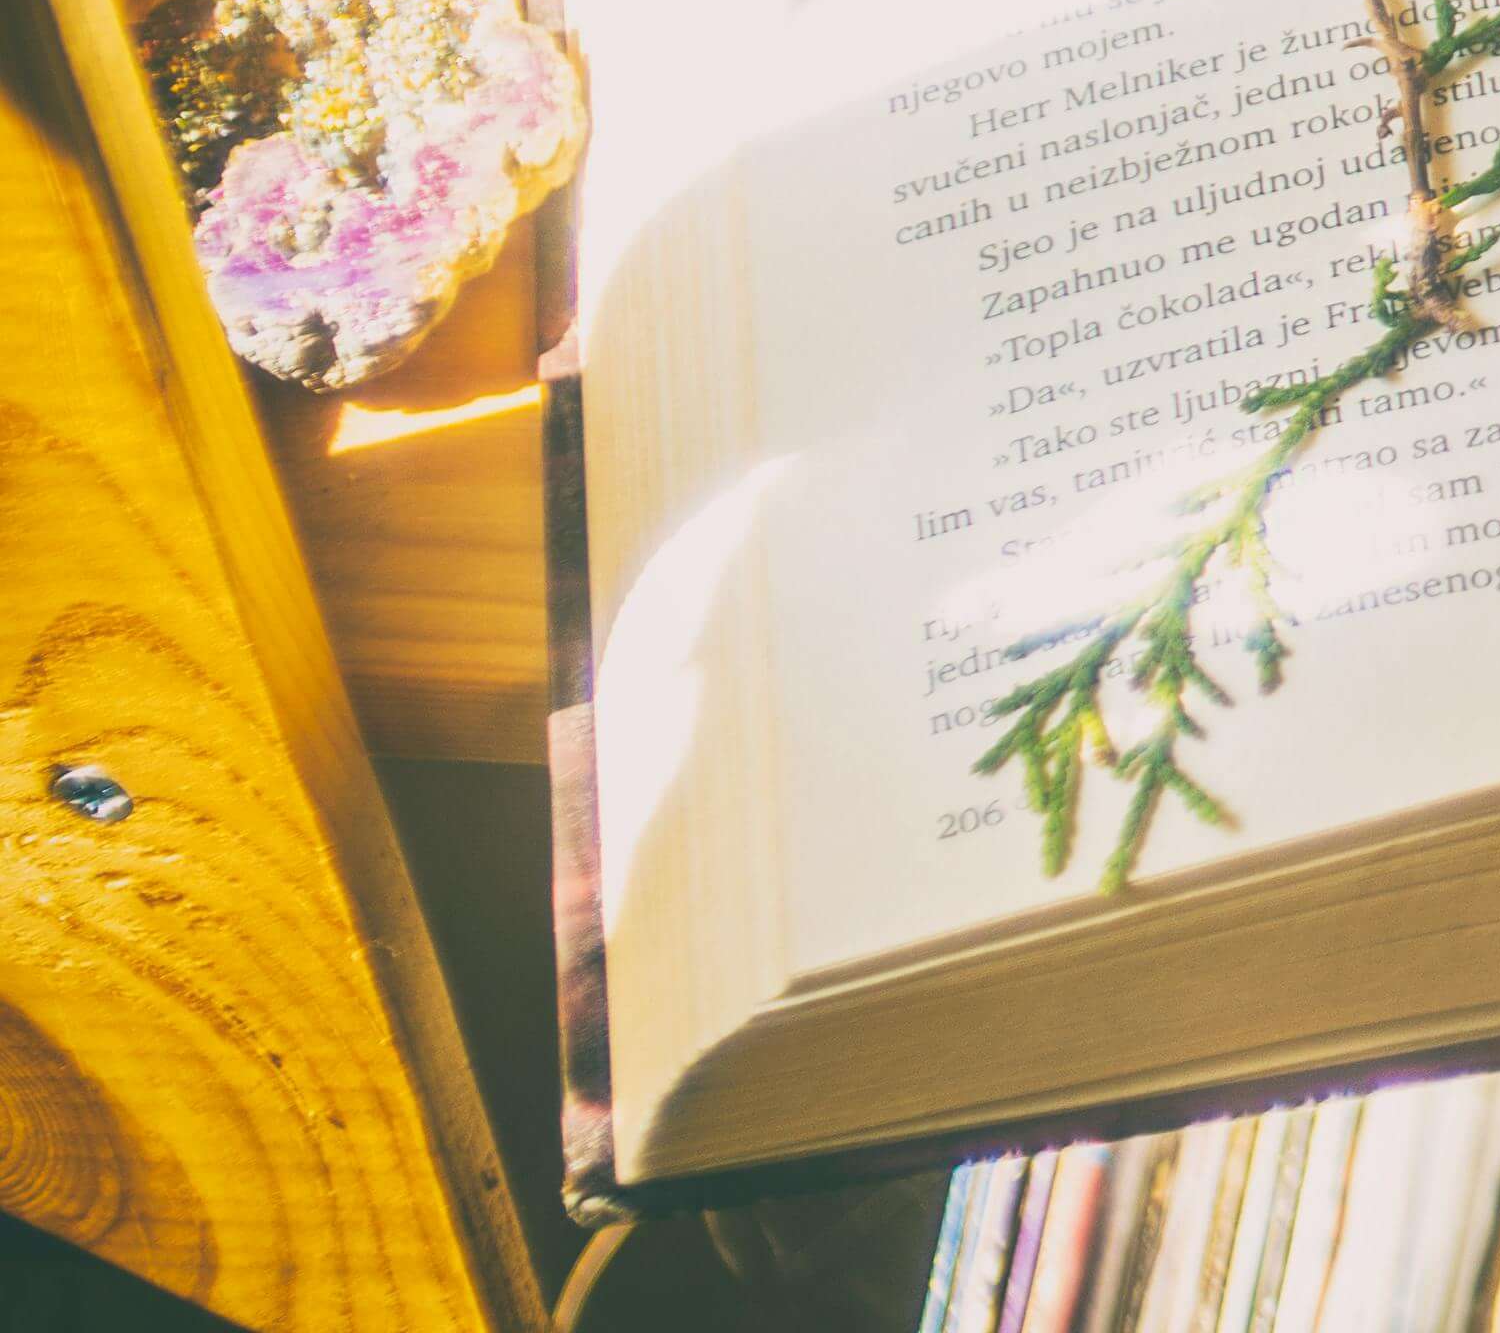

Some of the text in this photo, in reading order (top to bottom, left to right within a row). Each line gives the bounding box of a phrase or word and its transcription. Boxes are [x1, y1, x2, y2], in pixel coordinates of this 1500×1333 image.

[970, 42, 1267, 139] Herr Melniker je
[895, 128, 1276, 246] canih u neizbježnom
[978, 158, 1325, 273] Sjeo je na uljudnoj
[981, 200, 1388, 321] Zapahnuo me ugodan
[985, 271, 1314, 366] »Topla čokolada«,
[989, 314, 1311, 417] »Da«, uzvratila je
[1412, 434, 1450, 459] sa
[937, 799, 1005, 841] 206
